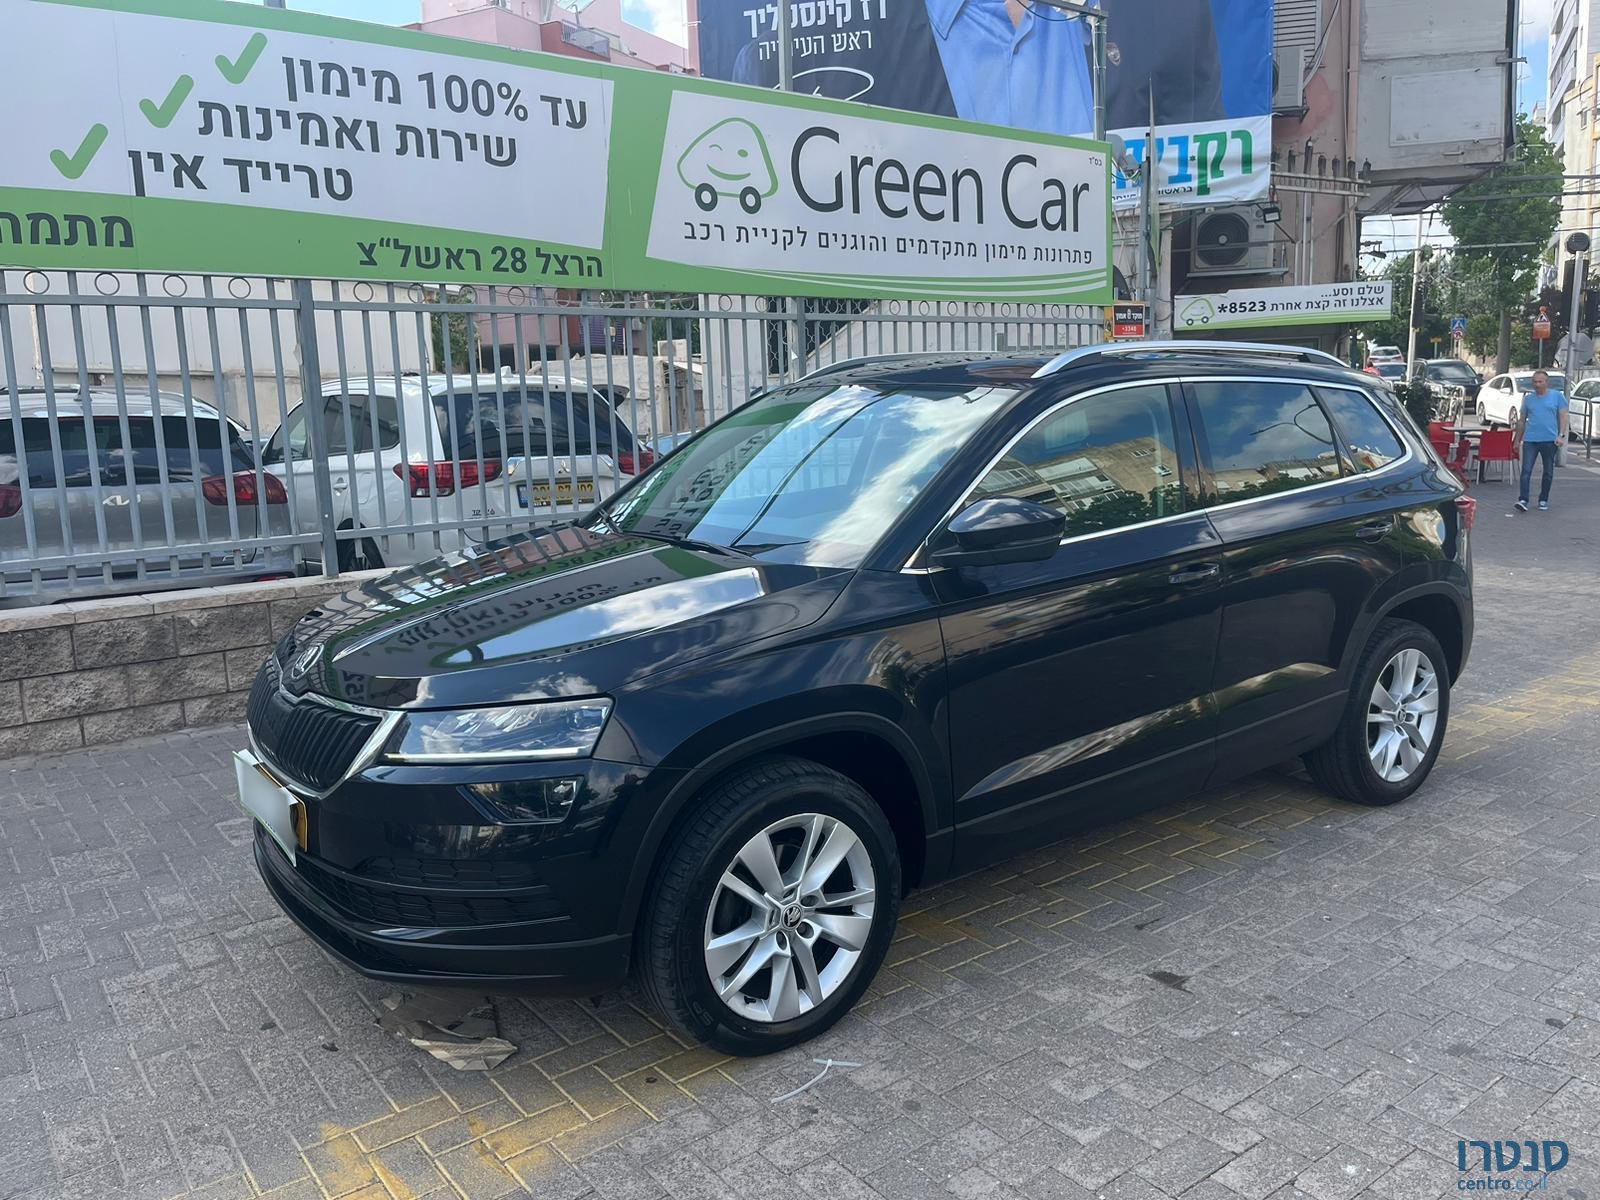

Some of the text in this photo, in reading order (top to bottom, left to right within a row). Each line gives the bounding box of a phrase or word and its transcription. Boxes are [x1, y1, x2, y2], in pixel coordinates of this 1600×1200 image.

[758, 30, 872, 61] ראש העייה
[282, 56, 588, 130] עד 100% מימון
[198, 101, 517, 168] שירות ואמינות
[127, 149, 353, 201] טרייד אין
[790, 126, 1090, 234] Green Car
[684, 222, 1092, 264] פתרונות מימון מתקדמים והוגנים לקניית רכב
[491, 246, 527, 273] 28
[536, 247, 603, 277] הרצל
[1270, 301, 1301, 311] אחרת
[1305, 300, 1330, 311] קצת
[1321, 285, 1384, 297] שלם וסע...
[1334, 299, 1347, 308] זה
[1351, 296, 1384, 307] אצלנו
